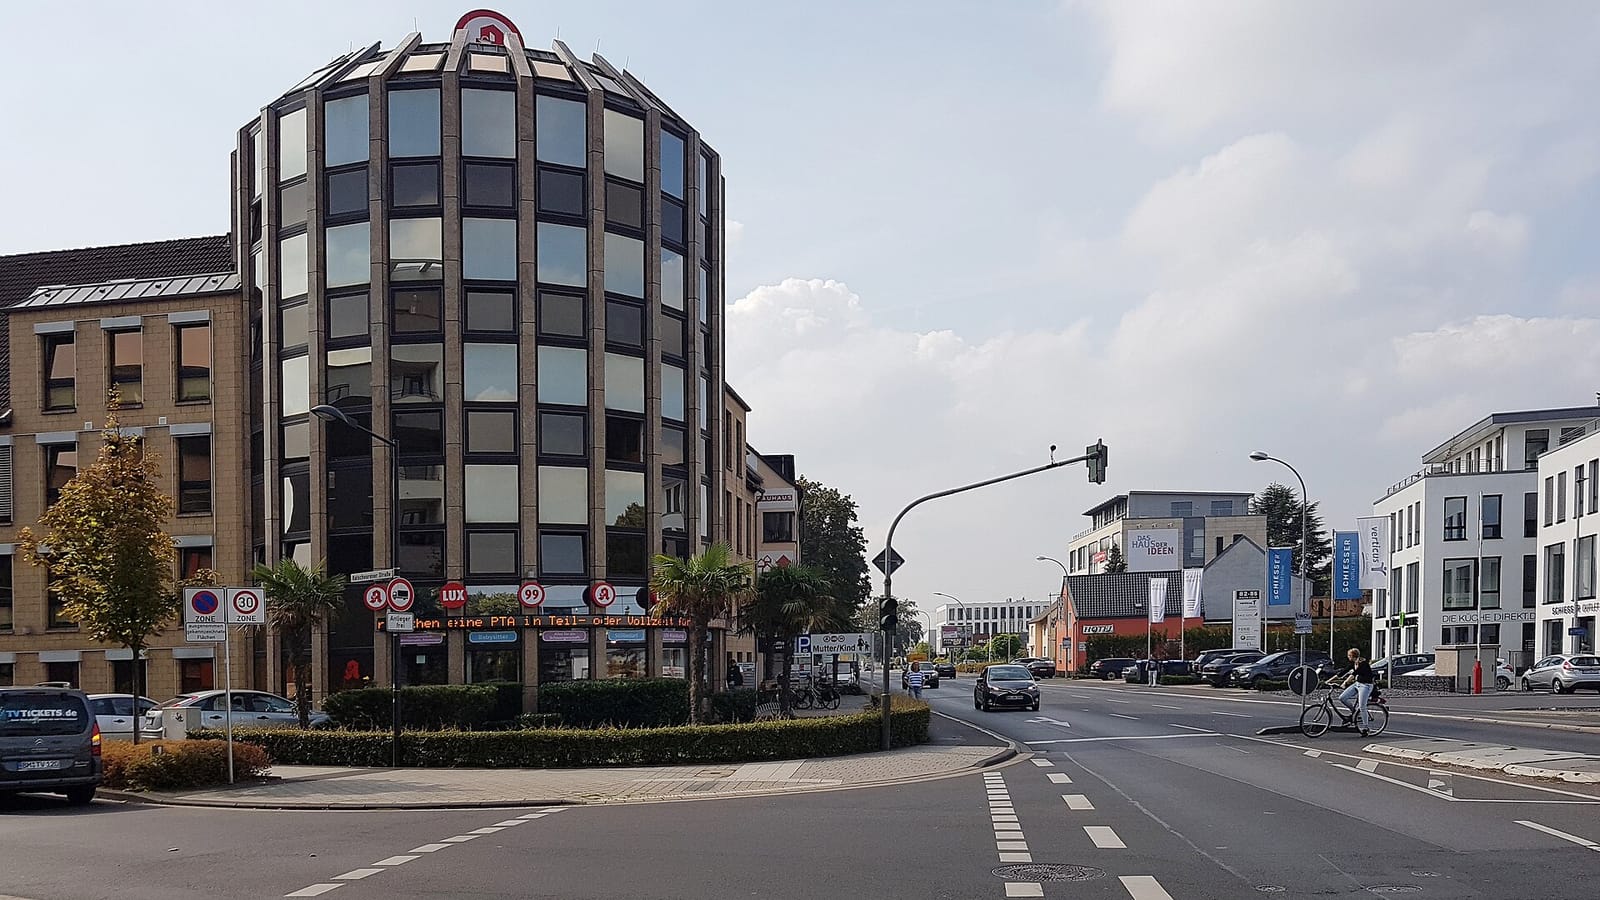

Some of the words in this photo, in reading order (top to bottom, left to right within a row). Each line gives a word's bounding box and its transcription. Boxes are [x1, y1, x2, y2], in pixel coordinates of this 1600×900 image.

[1132, 540, 1156, 548] HAUS
[1371, 526, 1381, 563] verticus
[1147, 547, 1174, 555] IDEEN
[1342, 539, 1351, 593] SCHIESSER
[442, 589, 465, 601] LUX
[524, 589, 539, 600] 99
[238, 596, 254, 608] 30
[1552, 604, 1581, 615] SCHIESSR
[390, 615, 411, 623] Anlieger
[490, 615, 516, 627] PTA
[524, 615, 541, 626] in
[548, 615, 586, 626] Teil-
[593, 616, 622, 626] oder
[1442, 614, 1457, 623] DIE
[1458, 612, 1491, 622] KÜCHE
[1083, 625, 1112, 633] HOTEL
[799, 636, 811, 653] P
[812, 643, 856, 652] Mutter/Kind
